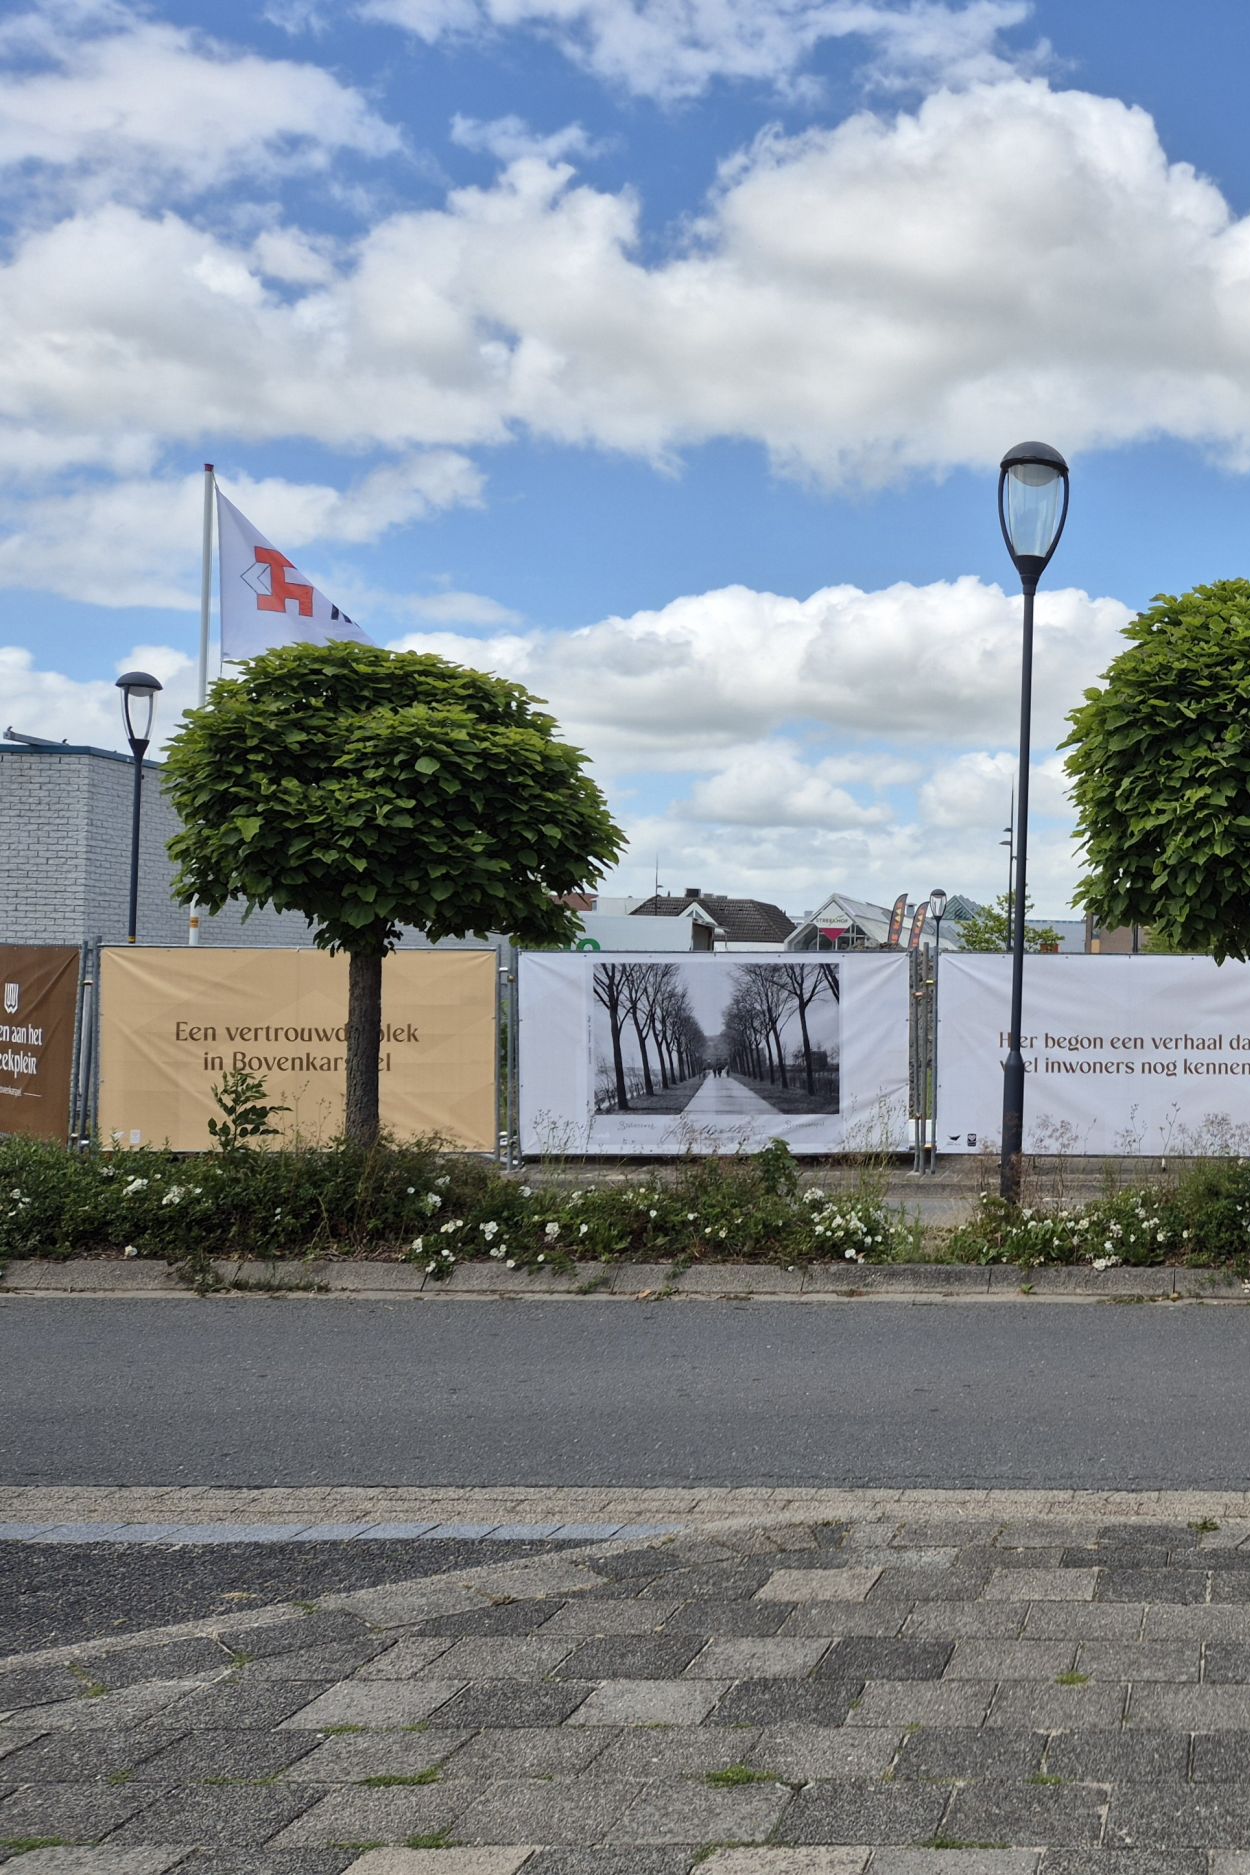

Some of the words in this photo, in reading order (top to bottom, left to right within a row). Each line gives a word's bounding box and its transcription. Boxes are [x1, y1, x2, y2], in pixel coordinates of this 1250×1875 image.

[11, 1026, 27, 1044] aan
[28, 1023, 43, 1046] het
[175, 1021, 217, 1042] Een
[225, 1023, 348, 1042] vertrouwd
[999, 1031, 1038, 1049] Her
[1045, 1032, 1104, 1051] begon
[1110, 1036, 1144, 1050] een
[1151, 1034, 1223, 1050] verhaal
[203, 1051, 224, 1071] in
[232, 1051, 391, 1071] Bovenkarel
[1045, 1057, 1135, 1074] inwoners
[1141, 1060, 1177, 1078] nog
